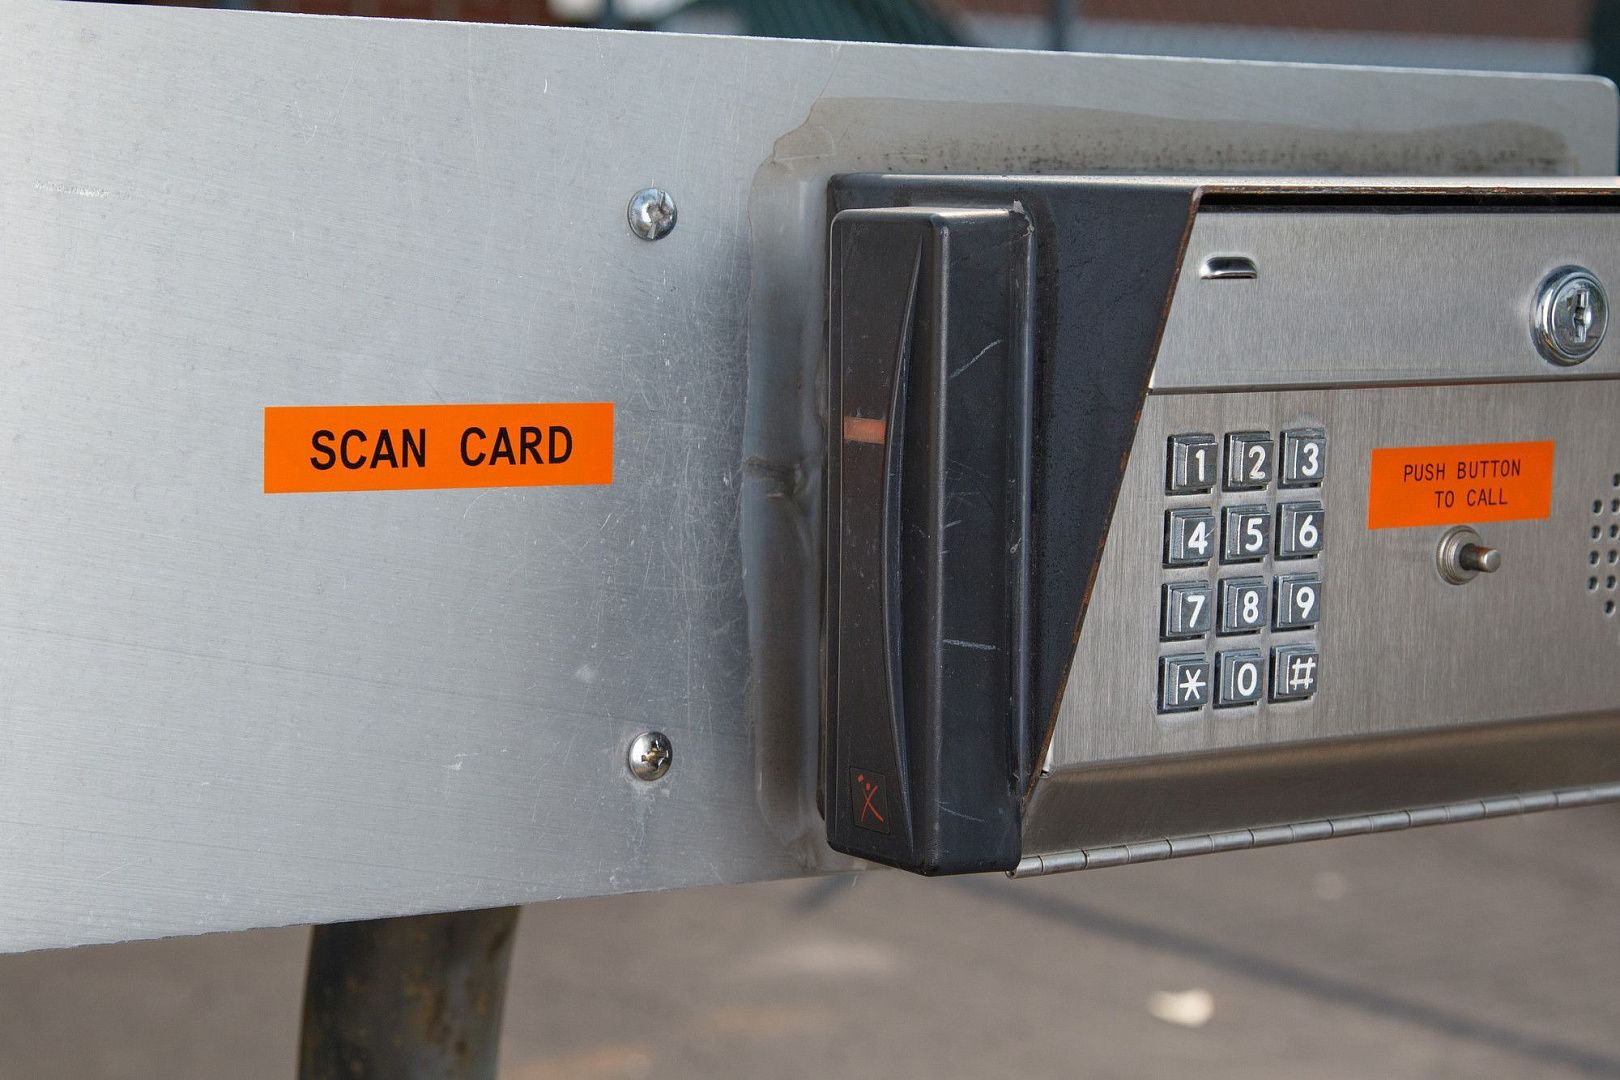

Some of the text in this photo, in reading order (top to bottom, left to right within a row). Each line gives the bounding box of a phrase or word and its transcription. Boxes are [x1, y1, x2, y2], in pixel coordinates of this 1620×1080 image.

[310, 425, 573, 471] SCAN CARD
[1195, 442, 1319, 482] 1 2 3
[1403, 459, 1521, 482] PUSH BUTTON
[1434, 488, 1508, 508] TO CALL
[1187, 514, 1319, 555] 4 5 6
[1186, 586, 1315, 628] 7 8 9
[1289, 657, 1316, 691] #
